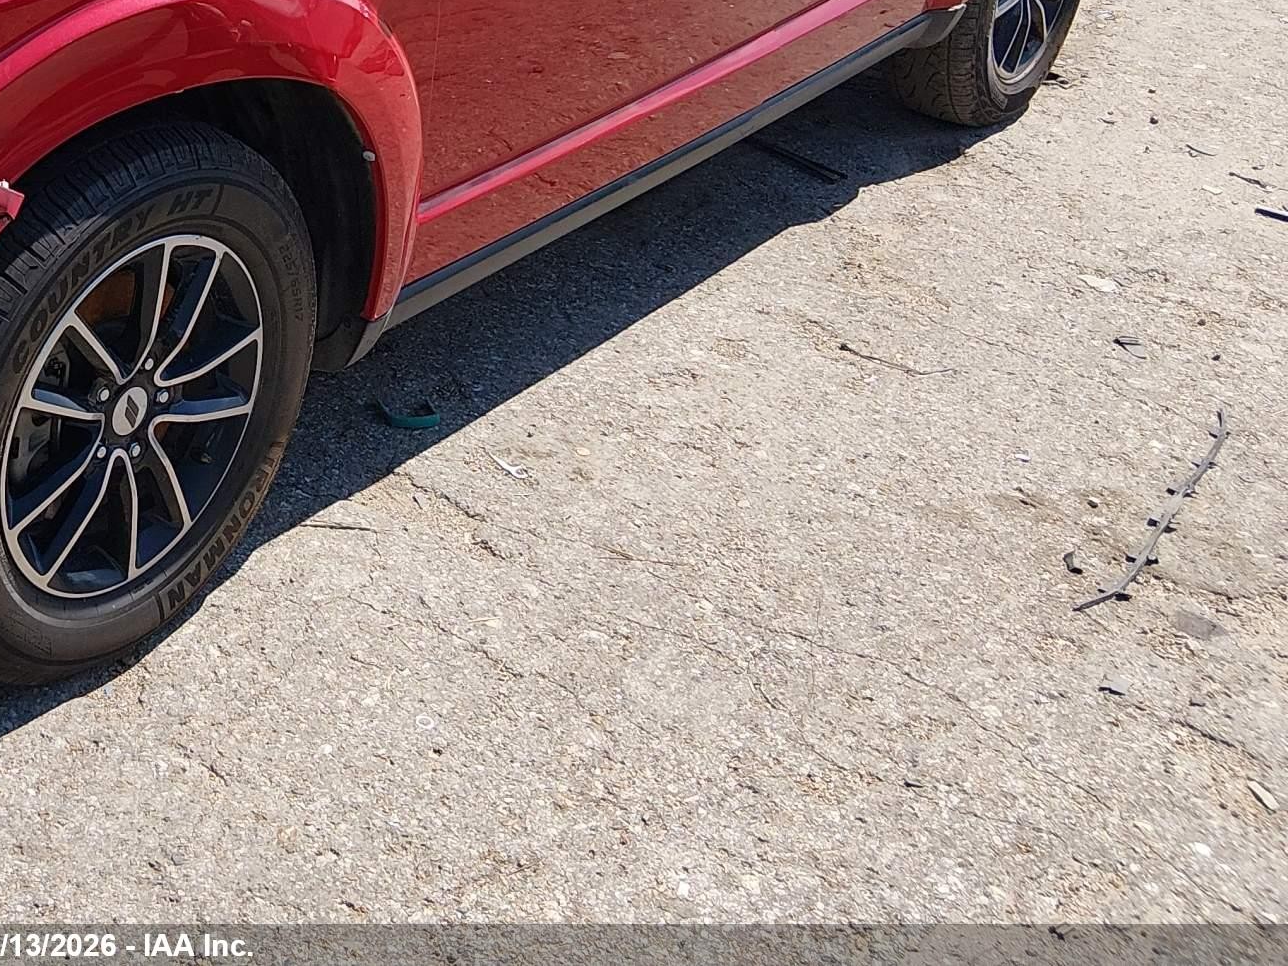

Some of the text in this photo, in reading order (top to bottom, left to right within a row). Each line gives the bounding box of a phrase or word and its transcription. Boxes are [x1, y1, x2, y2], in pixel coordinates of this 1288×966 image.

[14, 202, 155, 372] COUNTRY
[167, 189, 213, 216] HT
[166, 441, 285, 611] IRONMAN
